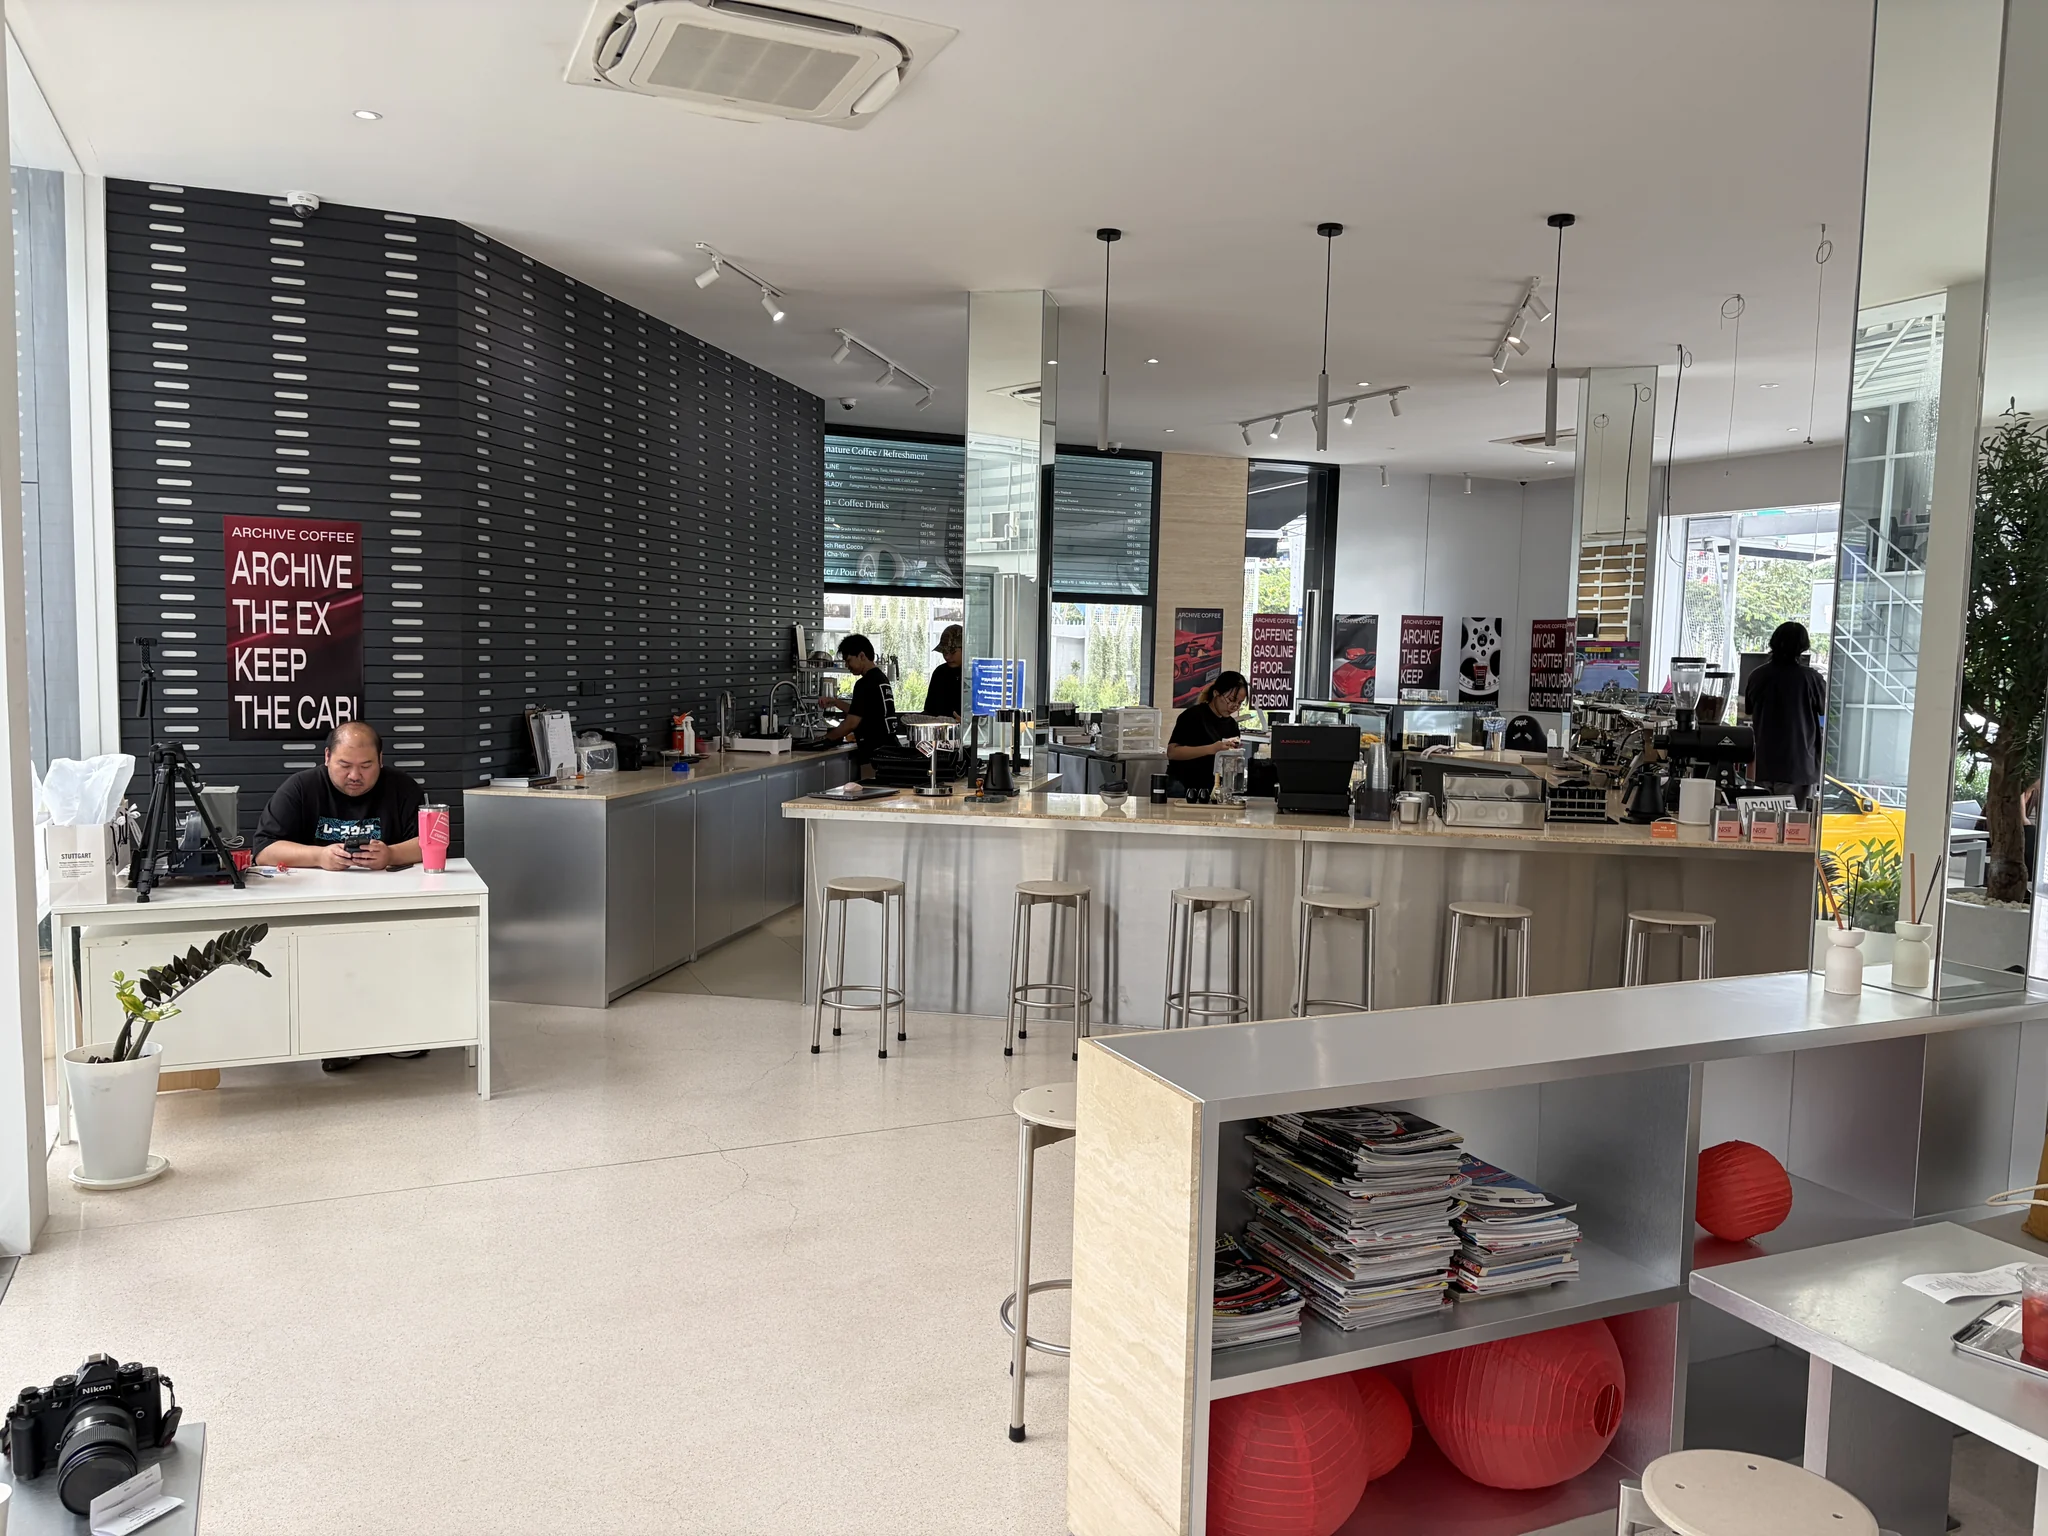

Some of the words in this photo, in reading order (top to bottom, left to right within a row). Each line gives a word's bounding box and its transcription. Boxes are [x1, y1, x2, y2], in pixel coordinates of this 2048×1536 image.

[824, 446, 850, 455] nature
[852, 446, 877, 456] Coffee
[883, 449, 928, 460] Refreshment
[838, 498, 864, 508] Coffee
[865, 500, 890, 509] Drinks
[232, 526, 296, 540] ARCHIVE
[299, 530, 355, 543] COFFEE
[231, 550, 353, 589] ARCHIVE
[840, 568, 857, 576] Pour
[858, 569, 877, 578] Over
[232, 599, 290, 634] THE
[296, 600, 332, 636] EX
[1254, 628, 1294, 641] CAFFEINE
[1402, 629, 1440, 645] ARCHIVE
[1533, 634, 1542, 648] MY
[1542, 634, 1555, 648] CAR
[1253, 645, 1294, 658] GASOLINE
[1402, 649, 1419, 664] THE
[1421, 650, 1432, 664] EX
[235, 647, 307, 682] KEEP
[1253, 661, 1258, 674] &
[1532, 653, 1538, 668] IS
[1538, 653, 1562, 668] HOTTER
[1400, 669, 1423, 684] KEEP
[1531, 673, 1548, 687] THAN
[1548, 673, 1564, 688] YOUR
[1252, 678, 1292, 690] FINANCIAL
[1251, 694, 1289, 707] DECISION
[235, 695, 291, 730] THE
[297, 695, 358, 729] CAR!
[323, 824, 374, 835] レースウェア
[61, 852, 91, 860] STUTTGART
[82, 1385, 111, 1394] Nikon
